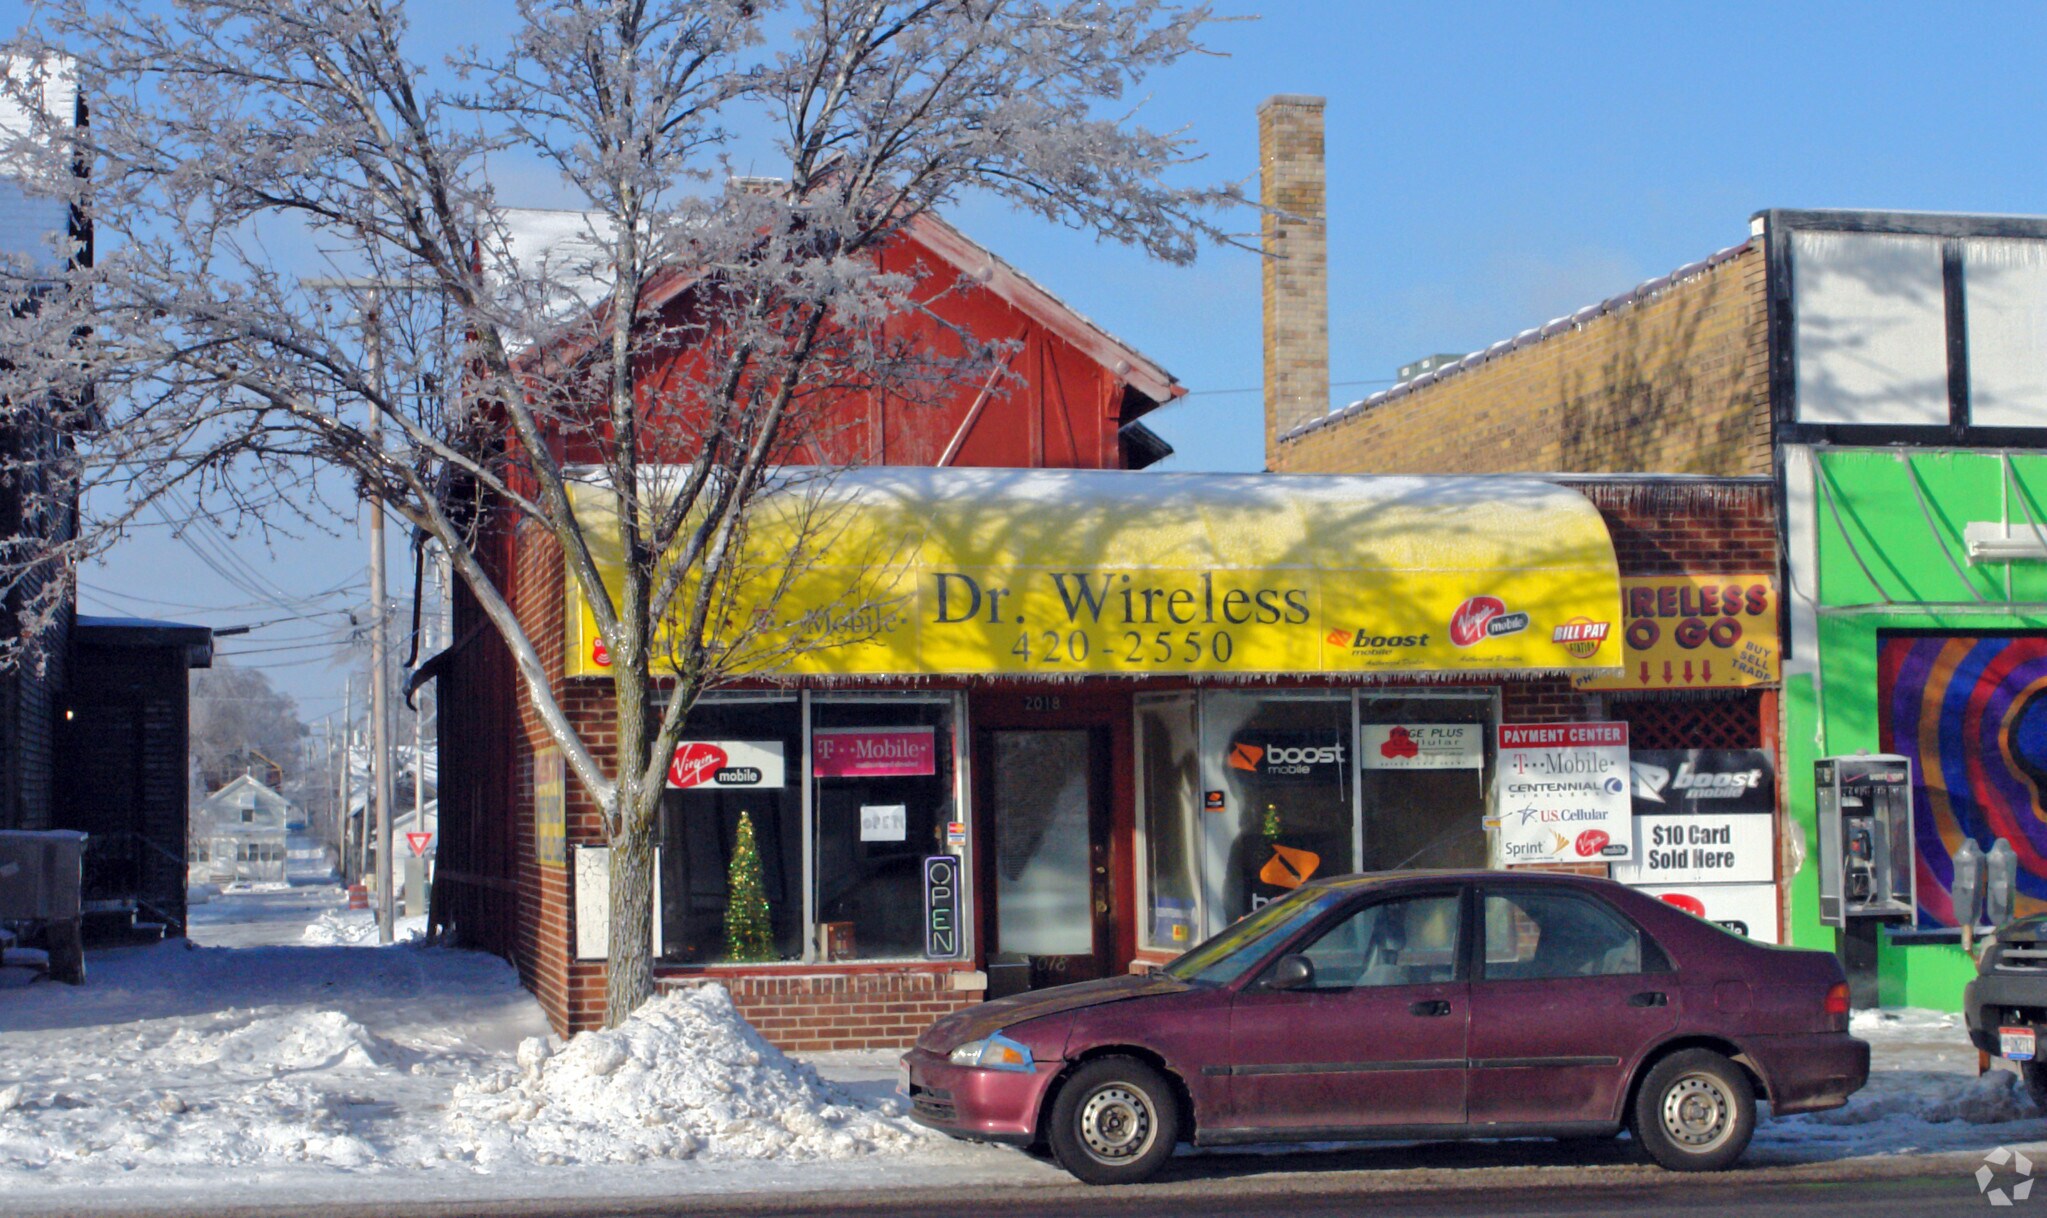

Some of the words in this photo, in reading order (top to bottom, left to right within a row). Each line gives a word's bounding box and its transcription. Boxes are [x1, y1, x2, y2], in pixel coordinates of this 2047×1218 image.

[932, 572, 1025, 624] Dr.
[1050, 571, 1311, 625] Wireless
[1490, 615, 1525, 635] mobile
[1553, 625, 1580, 641] BILL
[1582, 622, 1608, 639] PAY
[1675, 617, 1743, 649] GO
[1353, 628, 1430, 648] boost
[1746, 640, 1771, 657] BUY
[1740, 650, 1768, 670] SELL
[1025, 696, 1060, 710] 2018
[1430, 728, 1464, 738] PLUS
[1504, 728, 1565, 743] PAYMENT
[1569, 727, 1621, 742] CENTER
[1267, 742, 1346, 765] boost
[672, 744, 720, 784] Virgin
[718, 768, 758, 782] mobile
[1268, 764, 1310, 775] mobile
[1671, 762, 1763, 790] boost
[1508, 782, 1602, 793] CENTENNIAL
[1685, 786, 1745, 799] mobile
[1561, 808, 1609, 822] Cellular
[1652, 824, 1684, 847] $10
[1688, 824, 1731, 845] Card
[1505, 841, 1543, 857] Sprint
[1649, 849, 1689, 869] Sold
[1692, 847, 1735, 869] Here
[929, 862, 953, 952] OPEN
